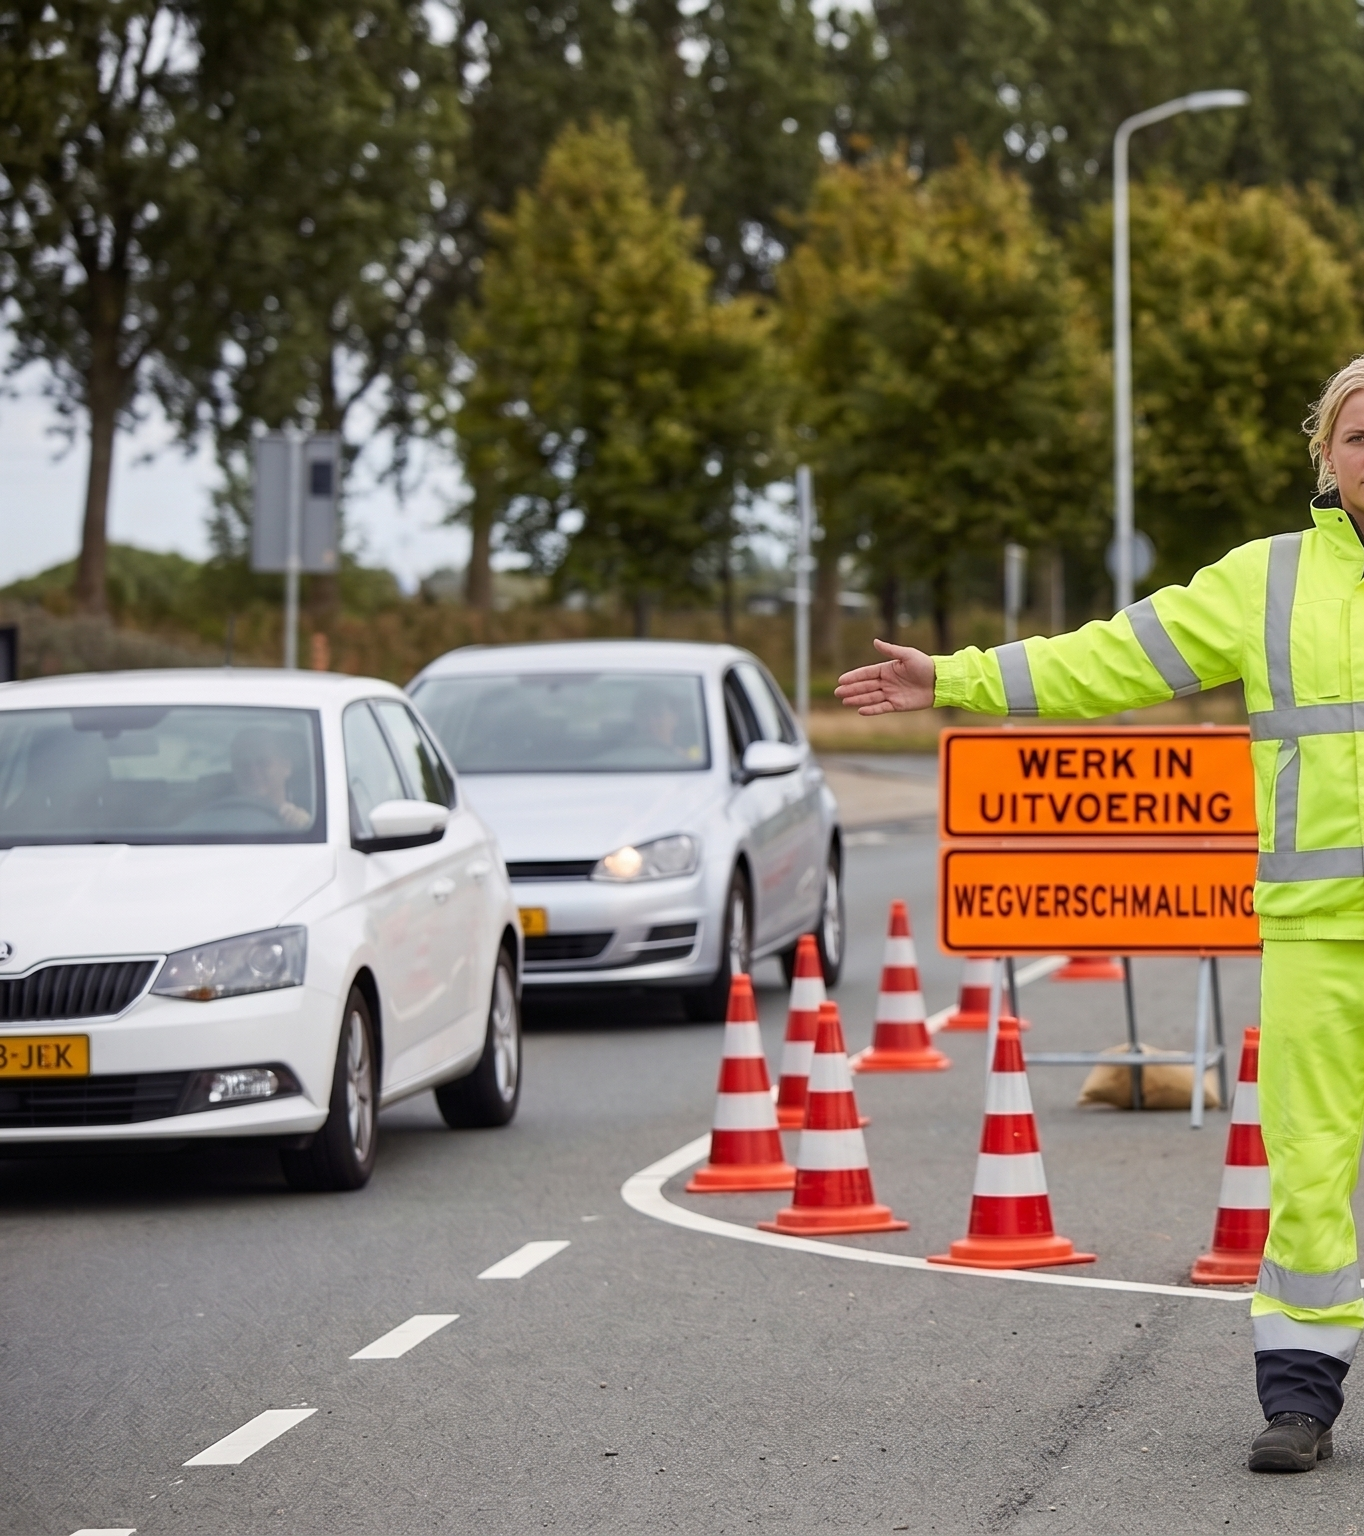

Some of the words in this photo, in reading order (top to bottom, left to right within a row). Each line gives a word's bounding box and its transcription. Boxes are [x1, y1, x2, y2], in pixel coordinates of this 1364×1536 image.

[1019, 748, 1136, 779] WERK
[1154, 748, 1192, 778] IN
[980, 792, 1232, 824] UITVOERING
[954, 884, 1254, 918] WEGVERSCHMALLING
